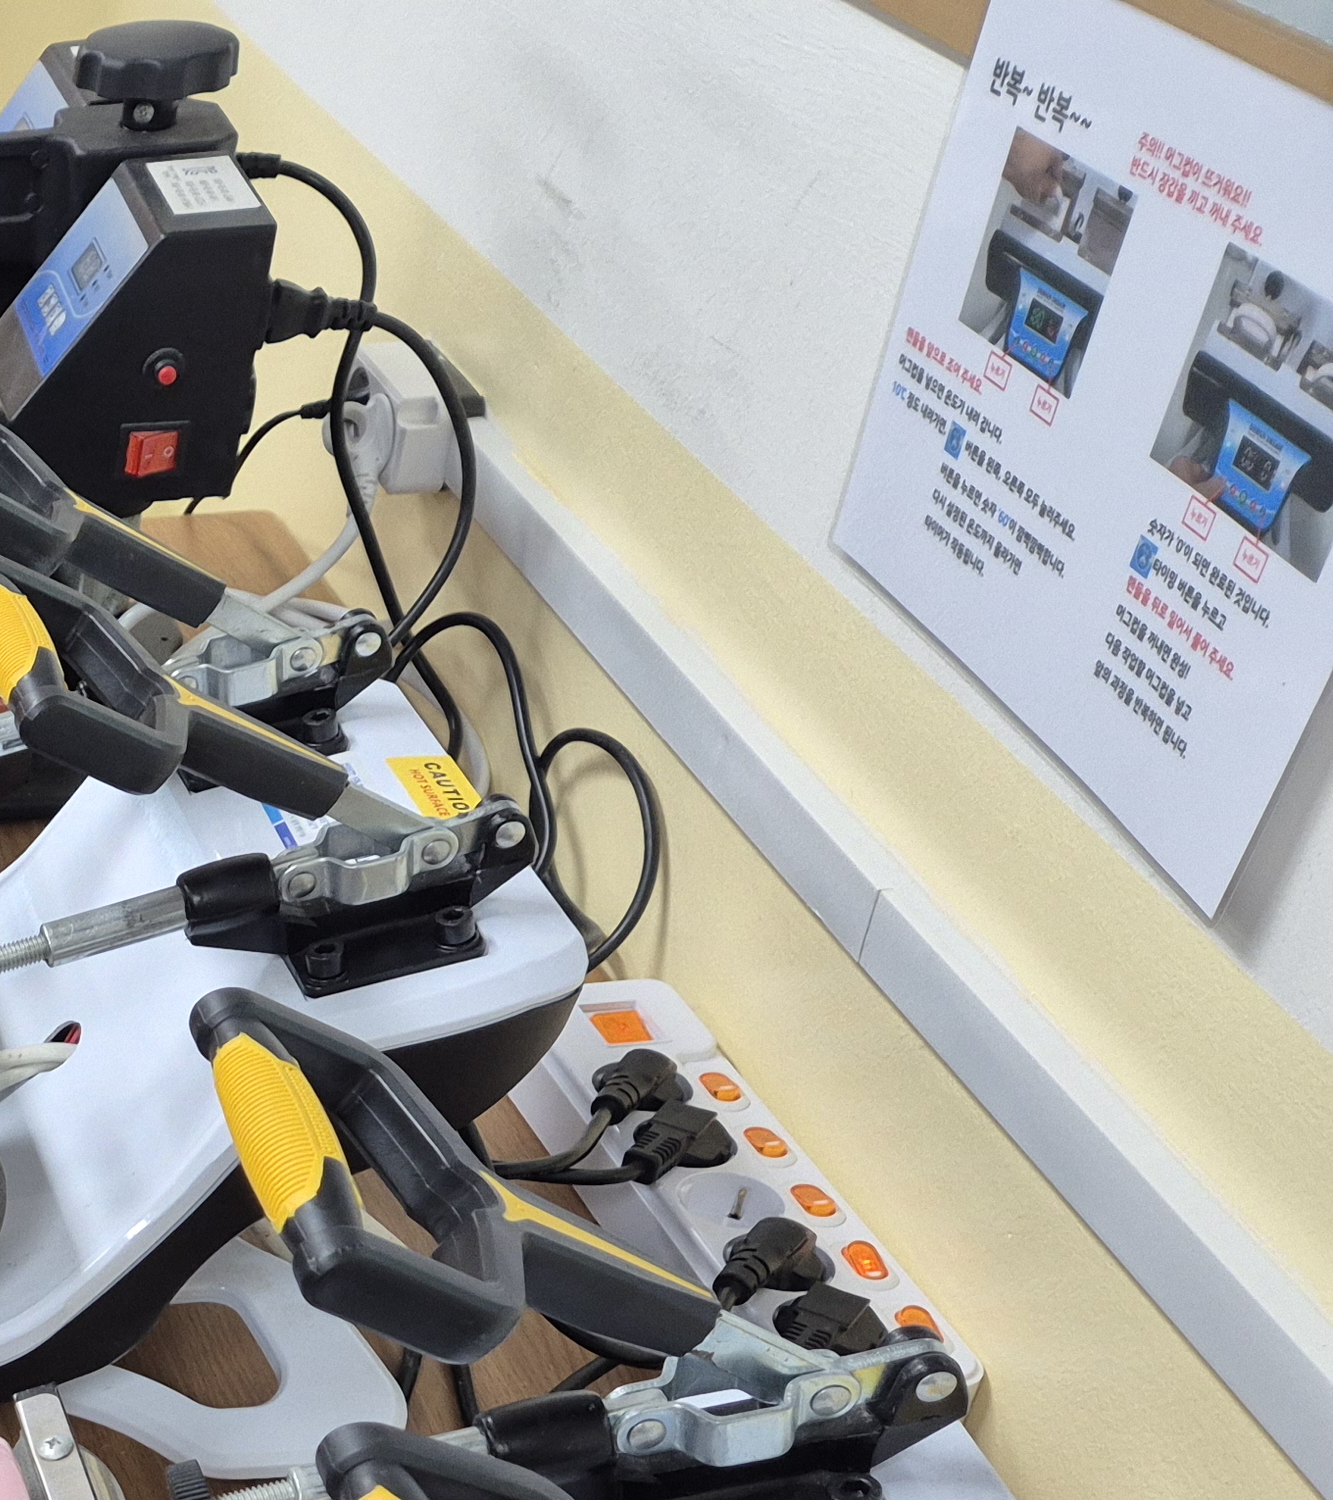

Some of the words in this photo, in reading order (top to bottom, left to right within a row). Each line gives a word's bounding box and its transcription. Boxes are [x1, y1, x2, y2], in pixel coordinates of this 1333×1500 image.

[990, 57, 1033, 105] 반복~
[1034, 82, 1092, 132] 반복~~
[1129, 155, 1158, 186] 반드시
[1158, 172, 1187, 204] 장갑을
[1187, 189, 1208, 214] 끼고
[1209, 202, 1232, 227] 꺼내
[1230, 214, 1262, 246] 주세요.
[1164, 147, 1203, 182] 머그컵이
[1201, 168, 1251, 207] 뜨거워요!!
[899, 354, 925, 384] 머그컵을
[925, 373, 945, 400] 넣으면
[944, 389, 966, 415] 온도가
[965, 405, 981, 426] 내려
[979, 416, 1002, 444] 갑니다.
[906, 327, 926, 353] 핸들을
[925, 342, 946, 366] 앞으로
[945, 357, 961, 378] 조여
[961, 368, 982, 395] 주세요.
[906, 392, 921, 412] 정도
[965, 440, 986, 467] 버튼을
[985, 456, 1001, 480] 왼쪽,
[1002, 470, 1025, 498] 오른쪽
[1023, 488, 1040, 510] 모두
[940, 463, 961, 490] 버튼을
[961, 479, 982, 508] 누르면
[981, 498, 997, 518] 숫자
[924, 515, 951, 546] 타이머가
[951, 537, 984, 576] 작동됩니다.
[932, 488, 947, 510] 다시
[946, 500, 967, 528] 설정된
[966, 518, 995, 550] 온도까지
[993, 541, 1022, 576] 올라가면
[1147, 519, 1175, 547] 숫자가
[1191, 552, 1211, 578] 되면
[1209, 566, 1236, 599] 완료된
[1233, 587, 1270, 628] 것입니다.
[1152, 558, 1178, 590] 타이밍
[1177, 579, 1202, 611] 버튼을
[1201, 600, 1227, 631] 누르고
[1116, 604, 1148, 642] 머그컵을
[1147, 631, 1173, 664] 꺼내면
[1169, 652, 1191, 679] 완성!
[1126, 575, 1151, 607] 핸들을
[1151, 596, 1169, 620] 뒤로
[1167, 610, 1193, 642] 밀어서
[1190, 632, 1210, 657] 풀어
[1208, 647, 1234, 681] 주세요.
[1093, 660, 1112, 684] 앞의
[1110, 675, 1135, 707] 과정을
[1133, 696, 1165, 736] 반복하면
[1162, 725, 1187, 759] 됩니다.
[1105, 632, 1122, 657] 다음
[1122, 646, 1146, 678] 작업할
[1145, 668, 1176, 707] 머그컵을
[1174, 696, 1192, 721] 넣고
[420, 784, 450, 816] SURFACE
